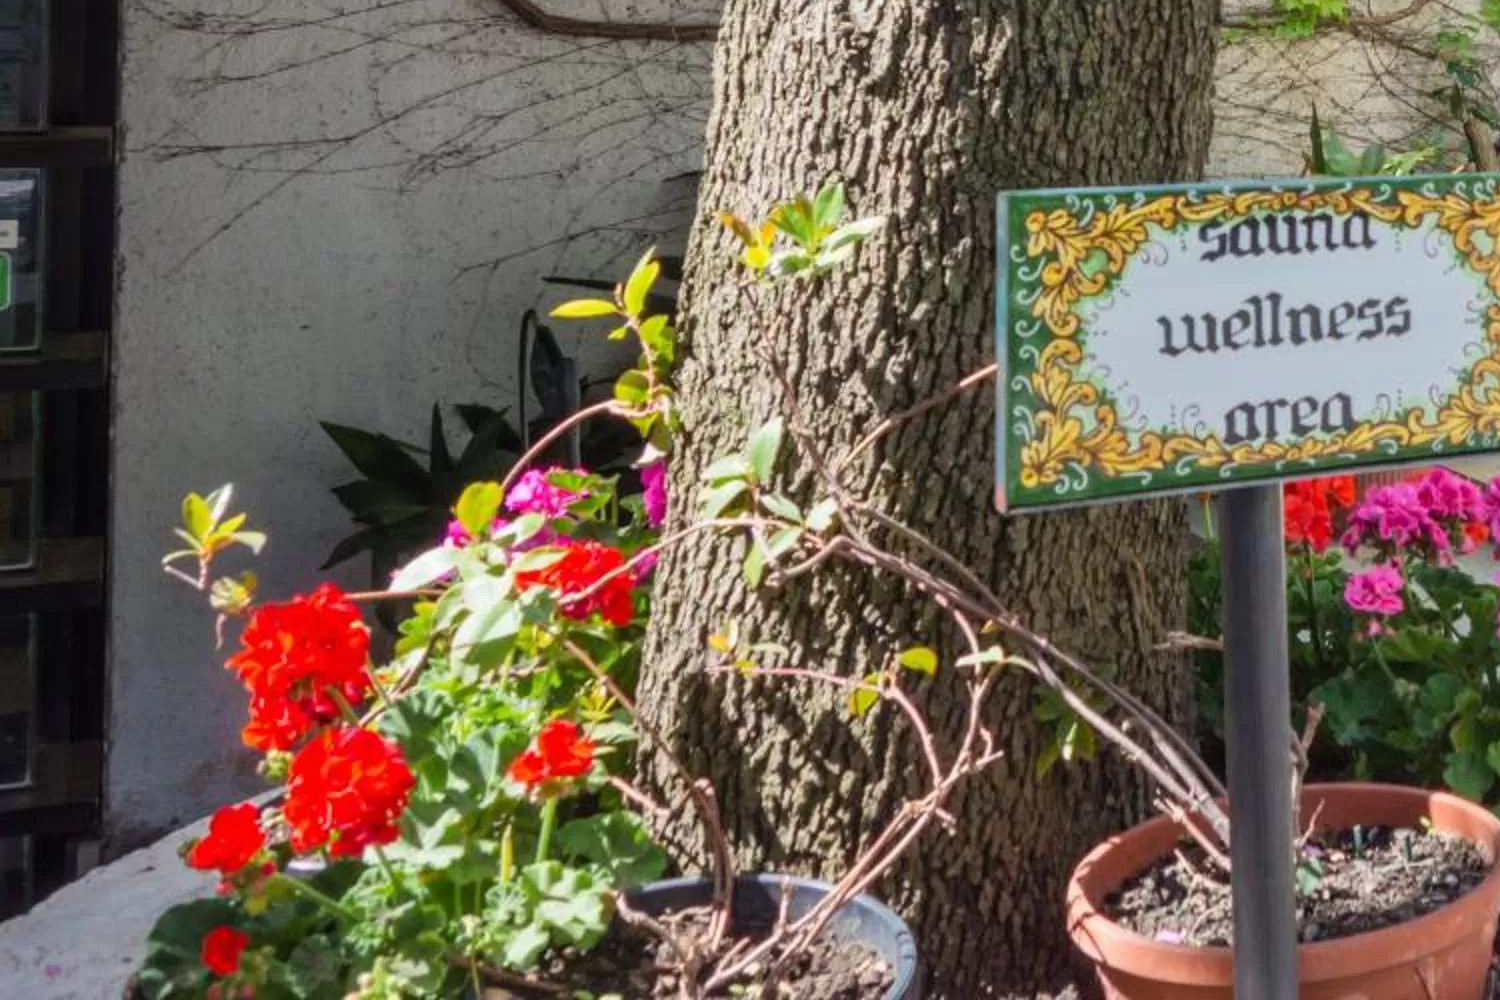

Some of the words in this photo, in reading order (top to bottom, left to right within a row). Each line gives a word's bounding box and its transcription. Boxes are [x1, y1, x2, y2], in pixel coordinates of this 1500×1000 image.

[1199, 211, 1376, 262] sauna
[1157, 292, 1411, 356] wellness
[1223, 392, 1358, 445] area
